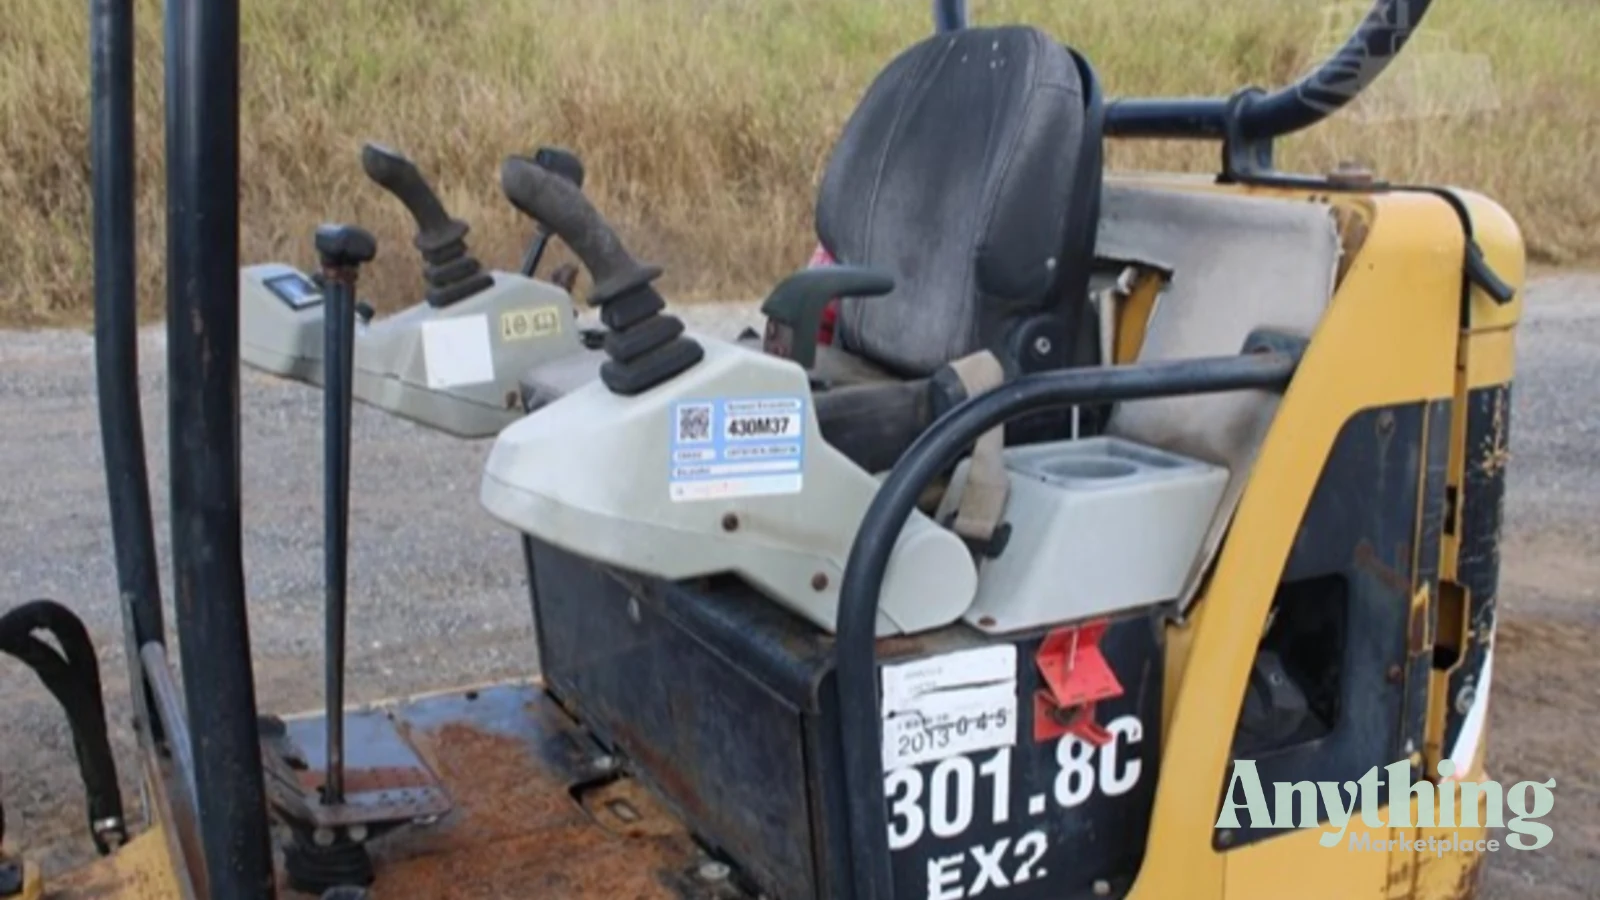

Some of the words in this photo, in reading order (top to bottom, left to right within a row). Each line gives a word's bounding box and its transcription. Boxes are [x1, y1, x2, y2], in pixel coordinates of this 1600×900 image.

[728, 416, 791, 437] 430M37
[897, 726, 950, 757] 2013
[883, 715, 1143, 851] 301.8C
[926, 830, 1049, 900] EX2
